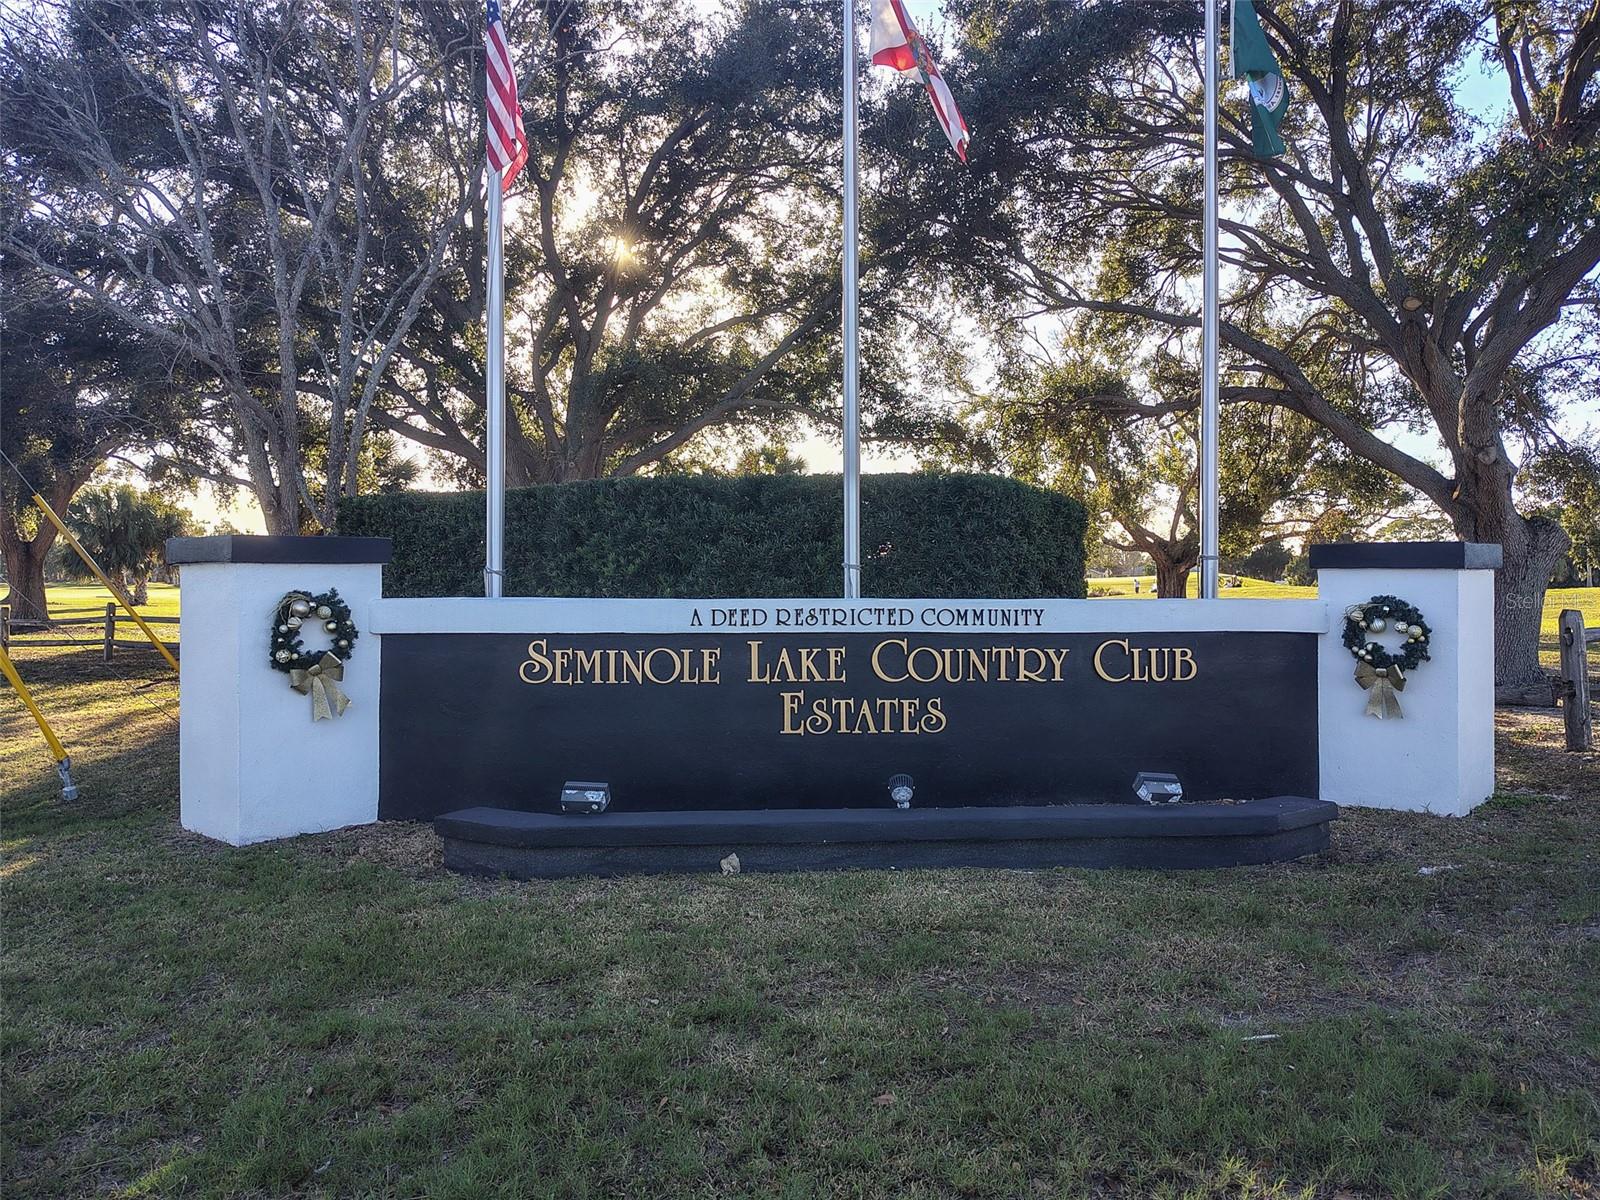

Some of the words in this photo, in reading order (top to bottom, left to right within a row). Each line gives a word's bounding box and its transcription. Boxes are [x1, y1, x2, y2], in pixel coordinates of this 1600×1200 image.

[691, 609, 703, 626] A
[711, 609, 768, 626] DEED
[776, 608, 913, 626] RESTRICTED
[921, 608, 1044, 626] COMMUNITY
[519, 639, 720, 685] SEMINOLE
[747, 641, 846, 685] LAKE
[872, 638, 1070, 682] COUNTRY
[1094, 638, 1197, 682] CLUB
[780, 690, 948, 736] ESTATES
